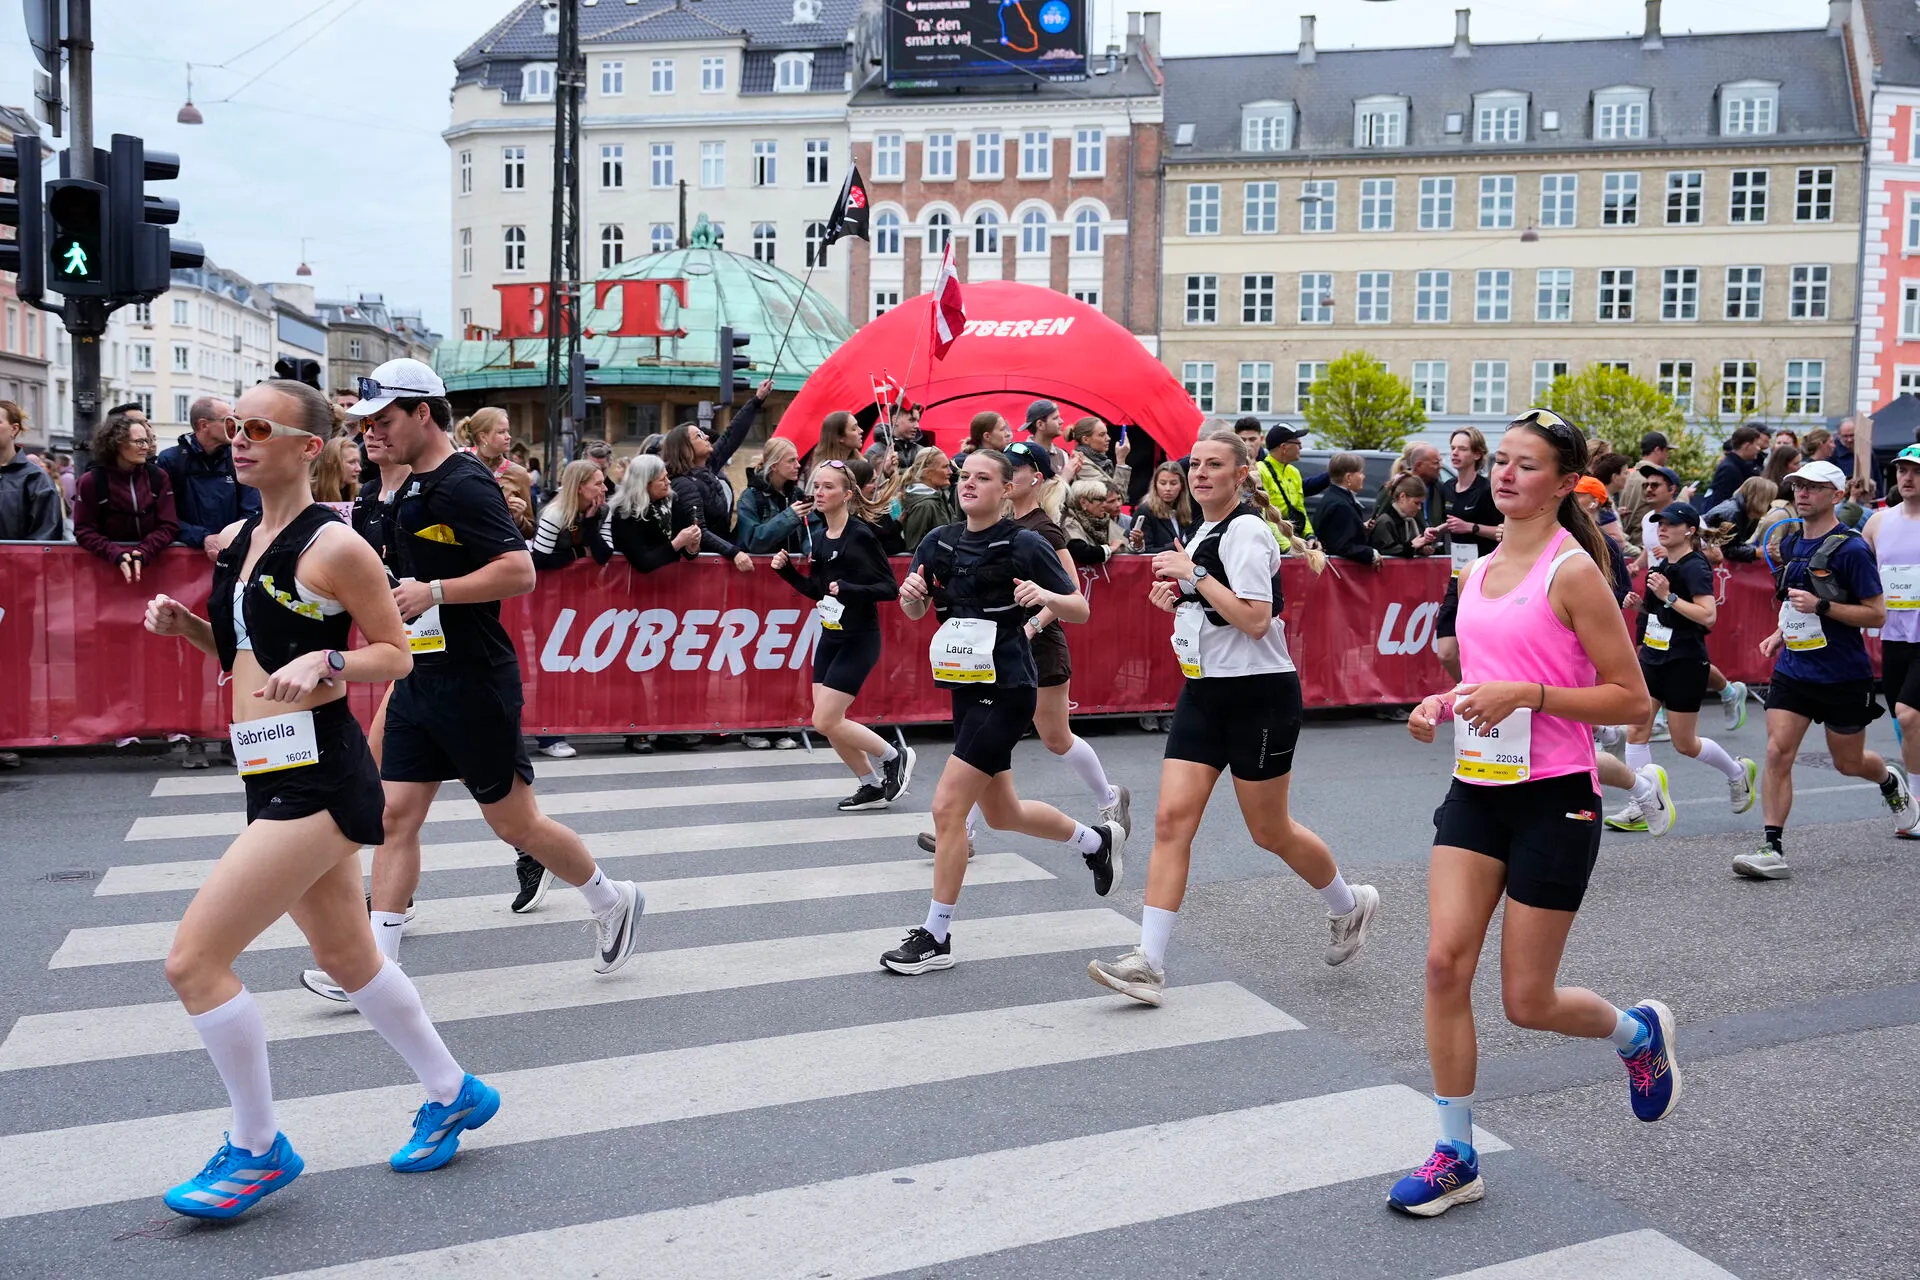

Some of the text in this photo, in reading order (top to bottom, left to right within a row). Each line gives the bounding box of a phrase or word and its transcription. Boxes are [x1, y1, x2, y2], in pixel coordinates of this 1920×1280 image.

[915, 18, 962, 32] Ta' den
[905, 31, 971, 47] smarte vej
[1890, 582, 1912, 590] Oscar
[1786, 622, 1806, 630] Asger
[420, 629, 440, 637] 24523
[946, 643, 973, 655] Laura
[1468, 722, 1499, 739] Fra
[285, 750, 312, 763] 16021
[1495, 753, 1524, 764] 22034
[919, 948, 937, 961] HOKA
